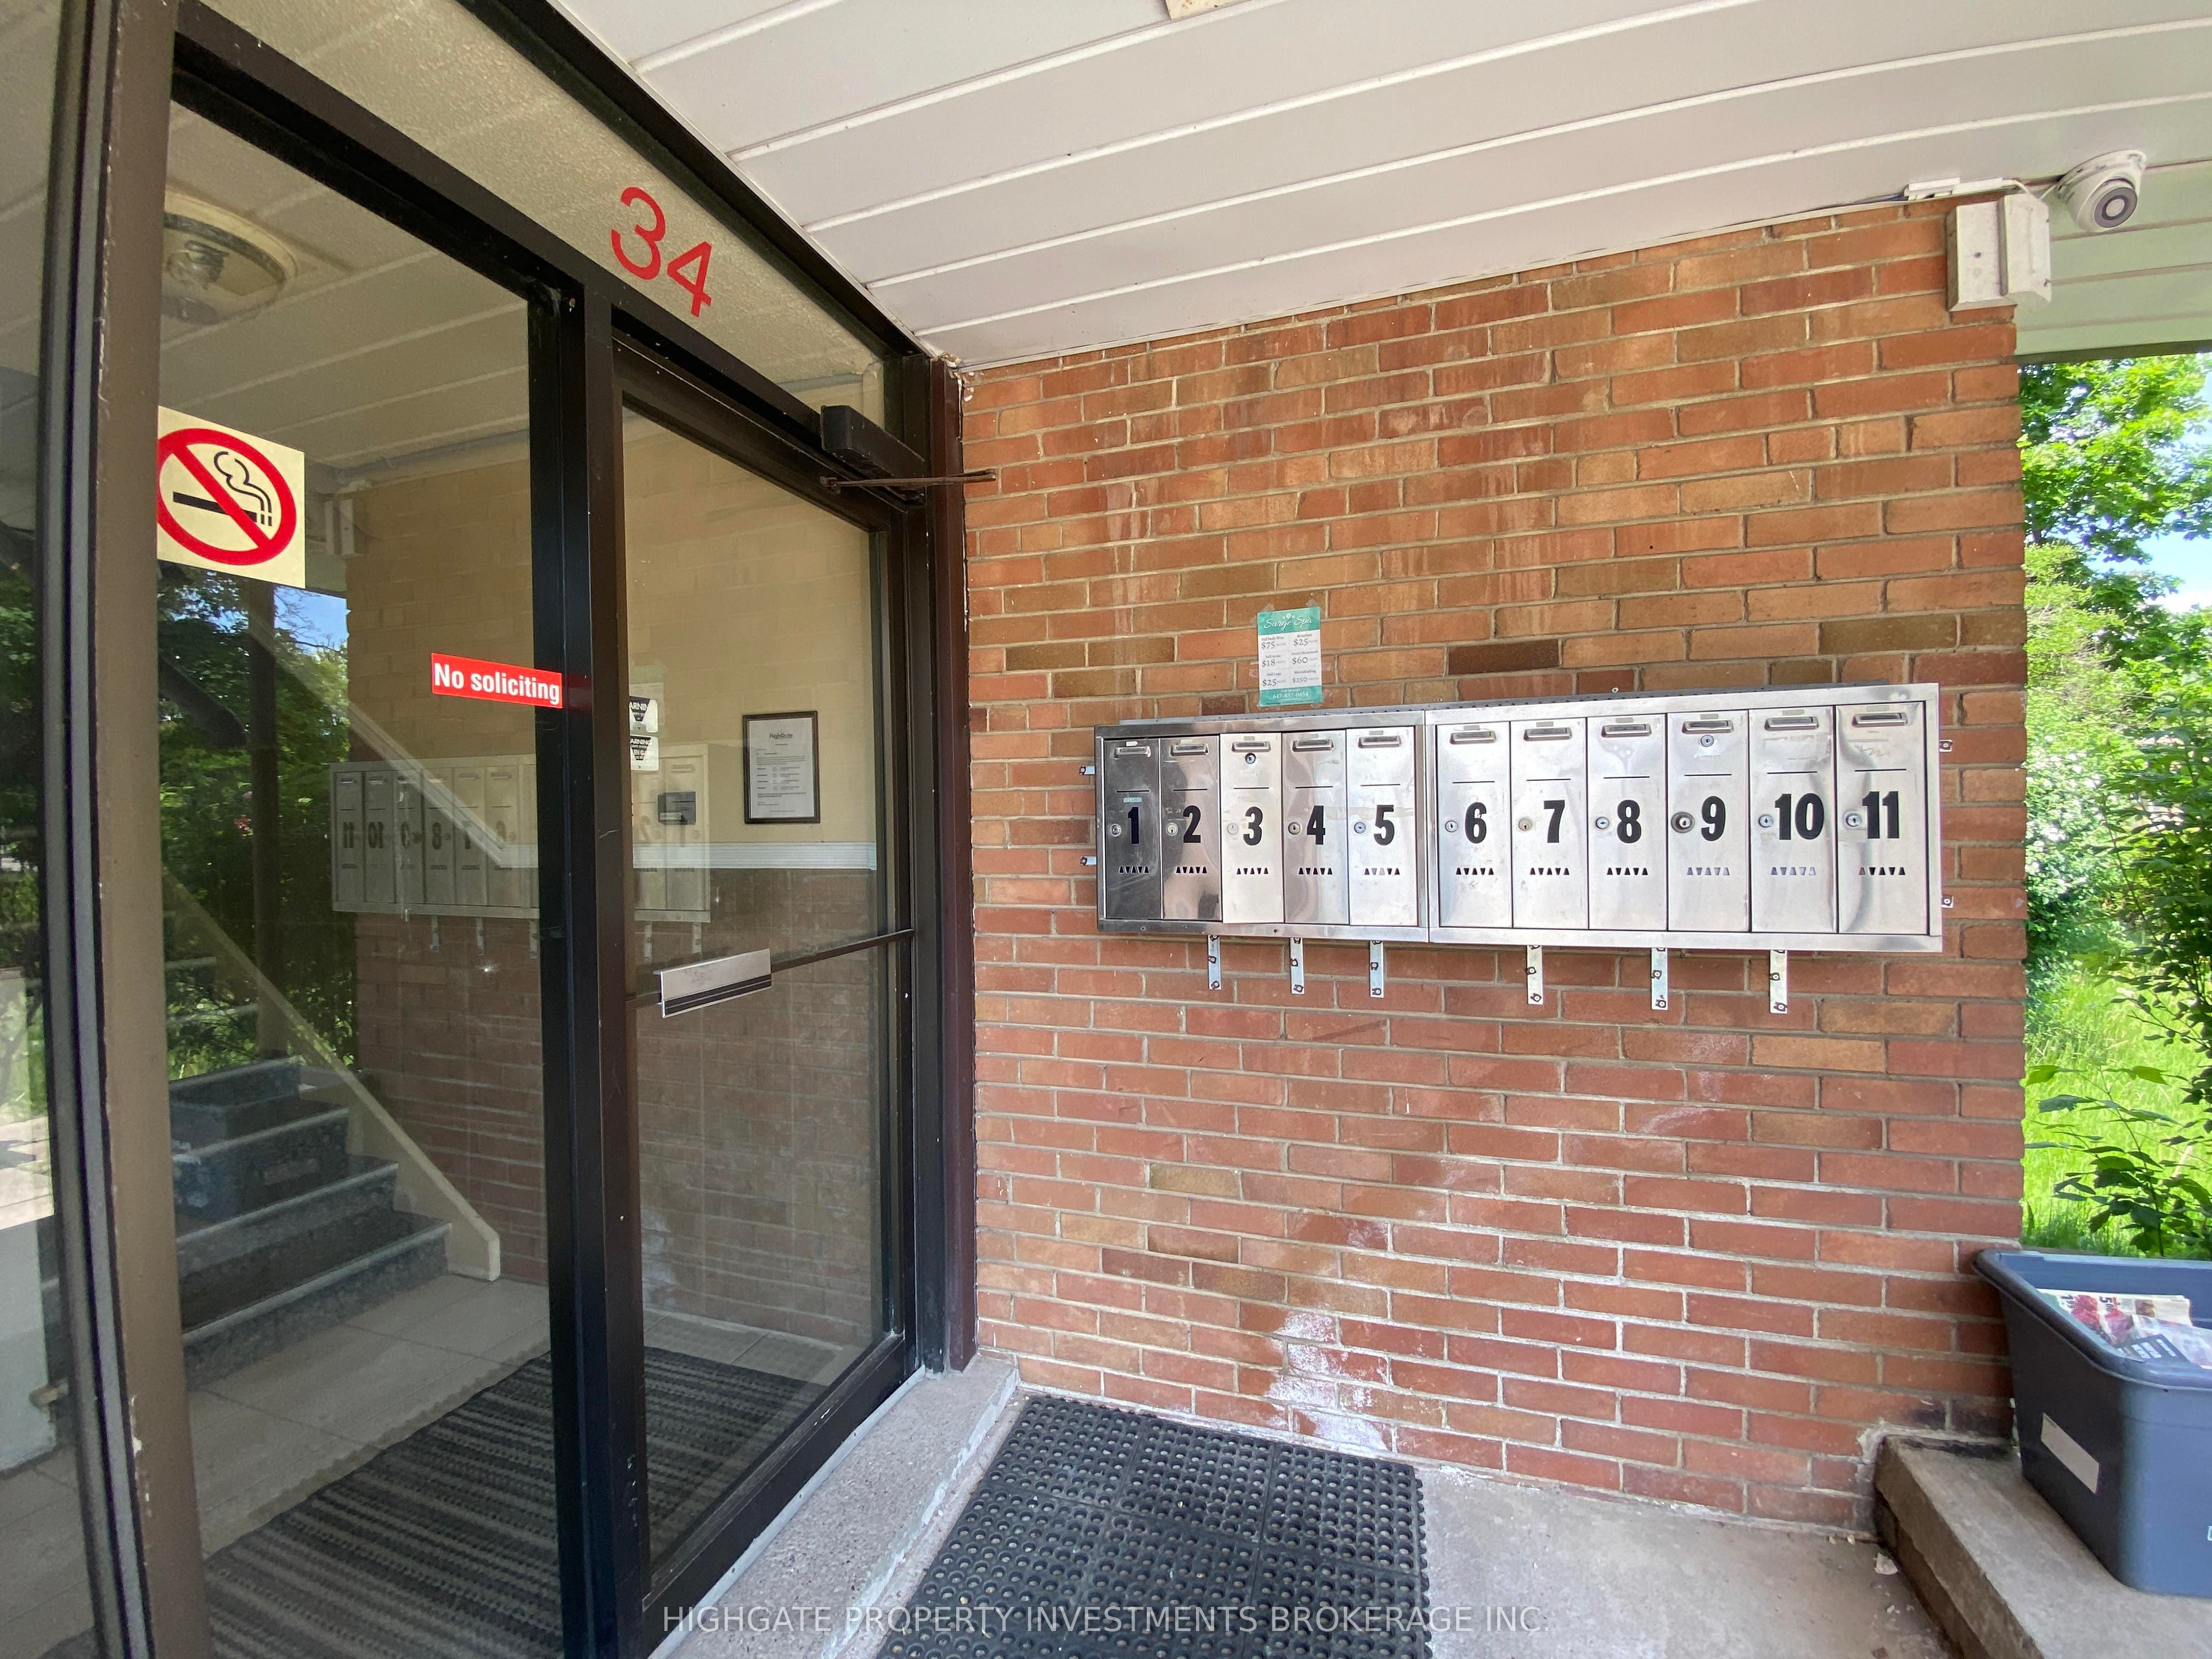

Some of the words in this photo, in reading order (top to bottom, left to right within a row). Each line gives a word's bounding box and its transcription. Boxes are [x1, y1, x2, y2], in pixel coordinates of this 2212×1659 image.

[611, 187, 712, 318] 34
[1294, 616, 1313, 629] Spa
[1261, 641, 1275, 650] $75
[1262, 658, 1276, 667] $18
[1292, 656, 1308, 664] $60
[434, 663, 464, 689] No
[470, 671, 560, 705] soliciting
[1262, 678, 1277, 686] $25
[1126, 806, 1139, 845] 1
[1182, 805, 1201, 844] 2
[1243, 806, 1263, 846] 3
[1306, 805, 1326, 845] 4
[1373, 804, 1395, 846] 5
[1465, 802, 1487, 844] 6
[1544, 800, 1565, 843] 7
[1617, 799, 1641, 844] 8
[1701, 795, 1726, 842] 9
[1775, 793, 1824, 840] 10
[1862, 791, 1900, 839] 11
